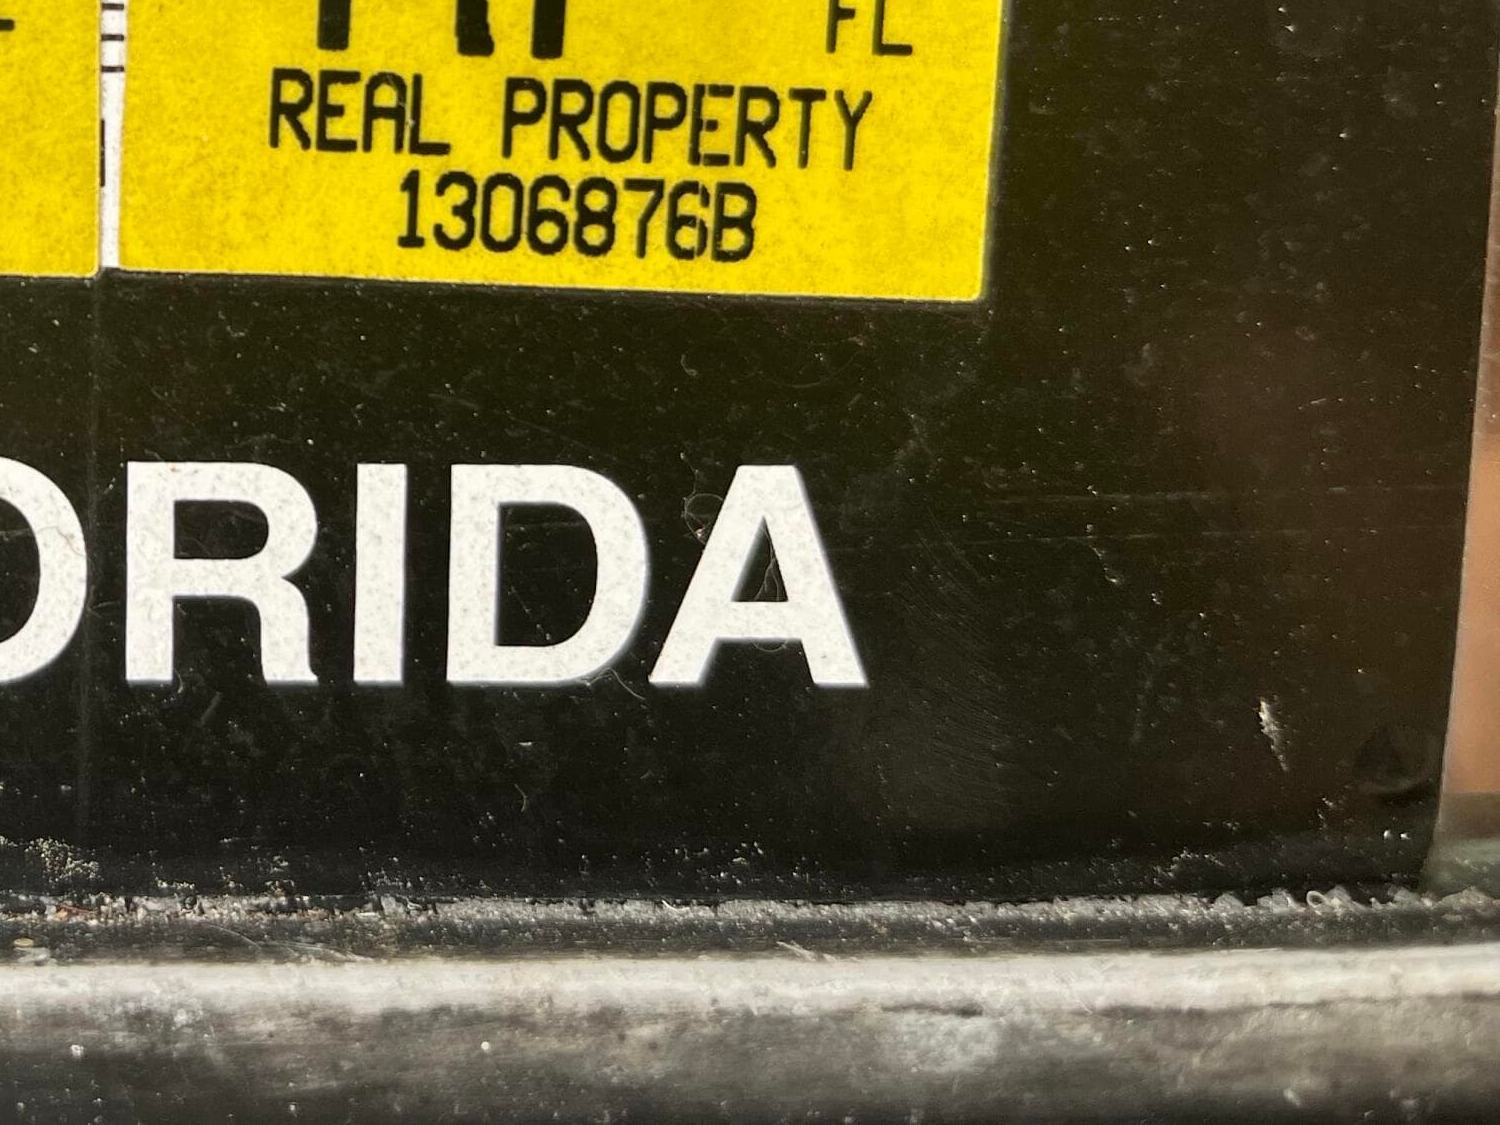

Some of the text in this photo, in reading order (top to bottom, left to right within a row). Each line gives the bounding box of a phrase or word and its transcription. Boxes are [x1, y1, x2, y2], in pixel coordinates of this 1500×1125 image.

[269, 67, 873, 171] REAL PROPERTY
[397, 169, 758, 263] 1306876B
